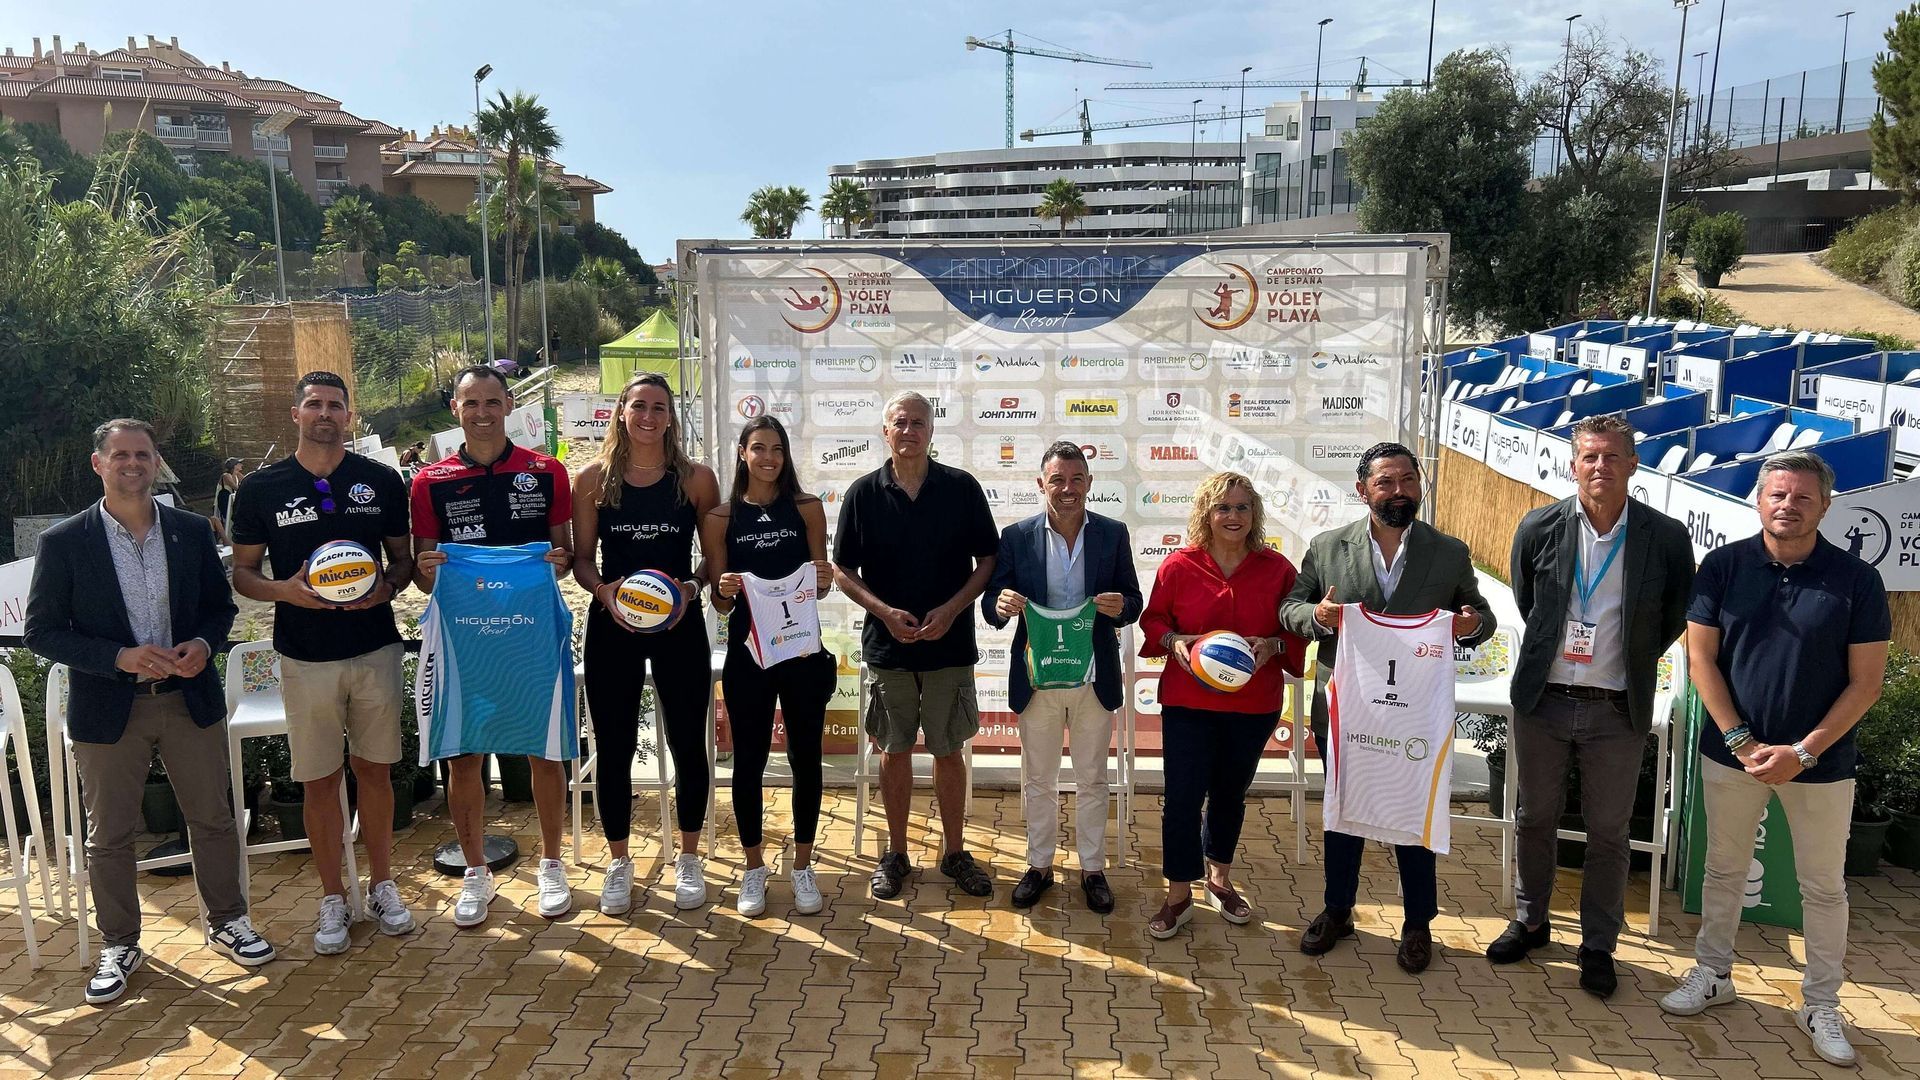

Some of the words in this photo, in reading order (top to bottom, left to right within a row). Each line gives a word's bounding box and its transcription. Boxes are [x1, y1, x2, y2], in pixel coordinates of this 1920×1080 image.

[1285, 276, 1323, 284] ESPAÑA
[849, 288, 891, 301] VÓLEY
[1267, 289, 1323, 306] VÓLEY
[850, 304, 891, 314] PLAYA
[1013, 308, 1076, 330] Resort
[1267, 309, 1322, 322] PLAYA
[754, 358, 796, 369] Iberdrola
[815, 358, 856, 366] AMBILAMP
[995, 356, 1040, 367] Andalucía
[1080, 356, 1124, 366] Iberdrola
[1332, 353, 1379, 365] Andalucía
[1323, 397, 1364, 409] MADISON
[1151, 445, 1198, 460] MARCA
[1086, 492, 1122, 503] ndalucía
[276, 506, 316, 520] MAX
[448, 514, 484, 525] Athletes
[450, 524, 485, 535] MAX
[632, 532, 659, 540] Resort
[1900, 534, 1920, 550] VÓ
[755, 539, 781, 549] Resort
[316, 553, 344, 566] BEACH
[1899, 553, 1920, 566] PL
[337, 587, 357, 595] FIVB
[627, 579, 650, 587] BEACH
[651, 585, 667, 595] PRO
[781, 601, 791, 618] 1
[478, 625, 512, 635] Resort
[783, 630, 811, 642] Iberdrola
[1057, 625, 1064, 642] 1
[1387, 660, 1396, 686] 1
